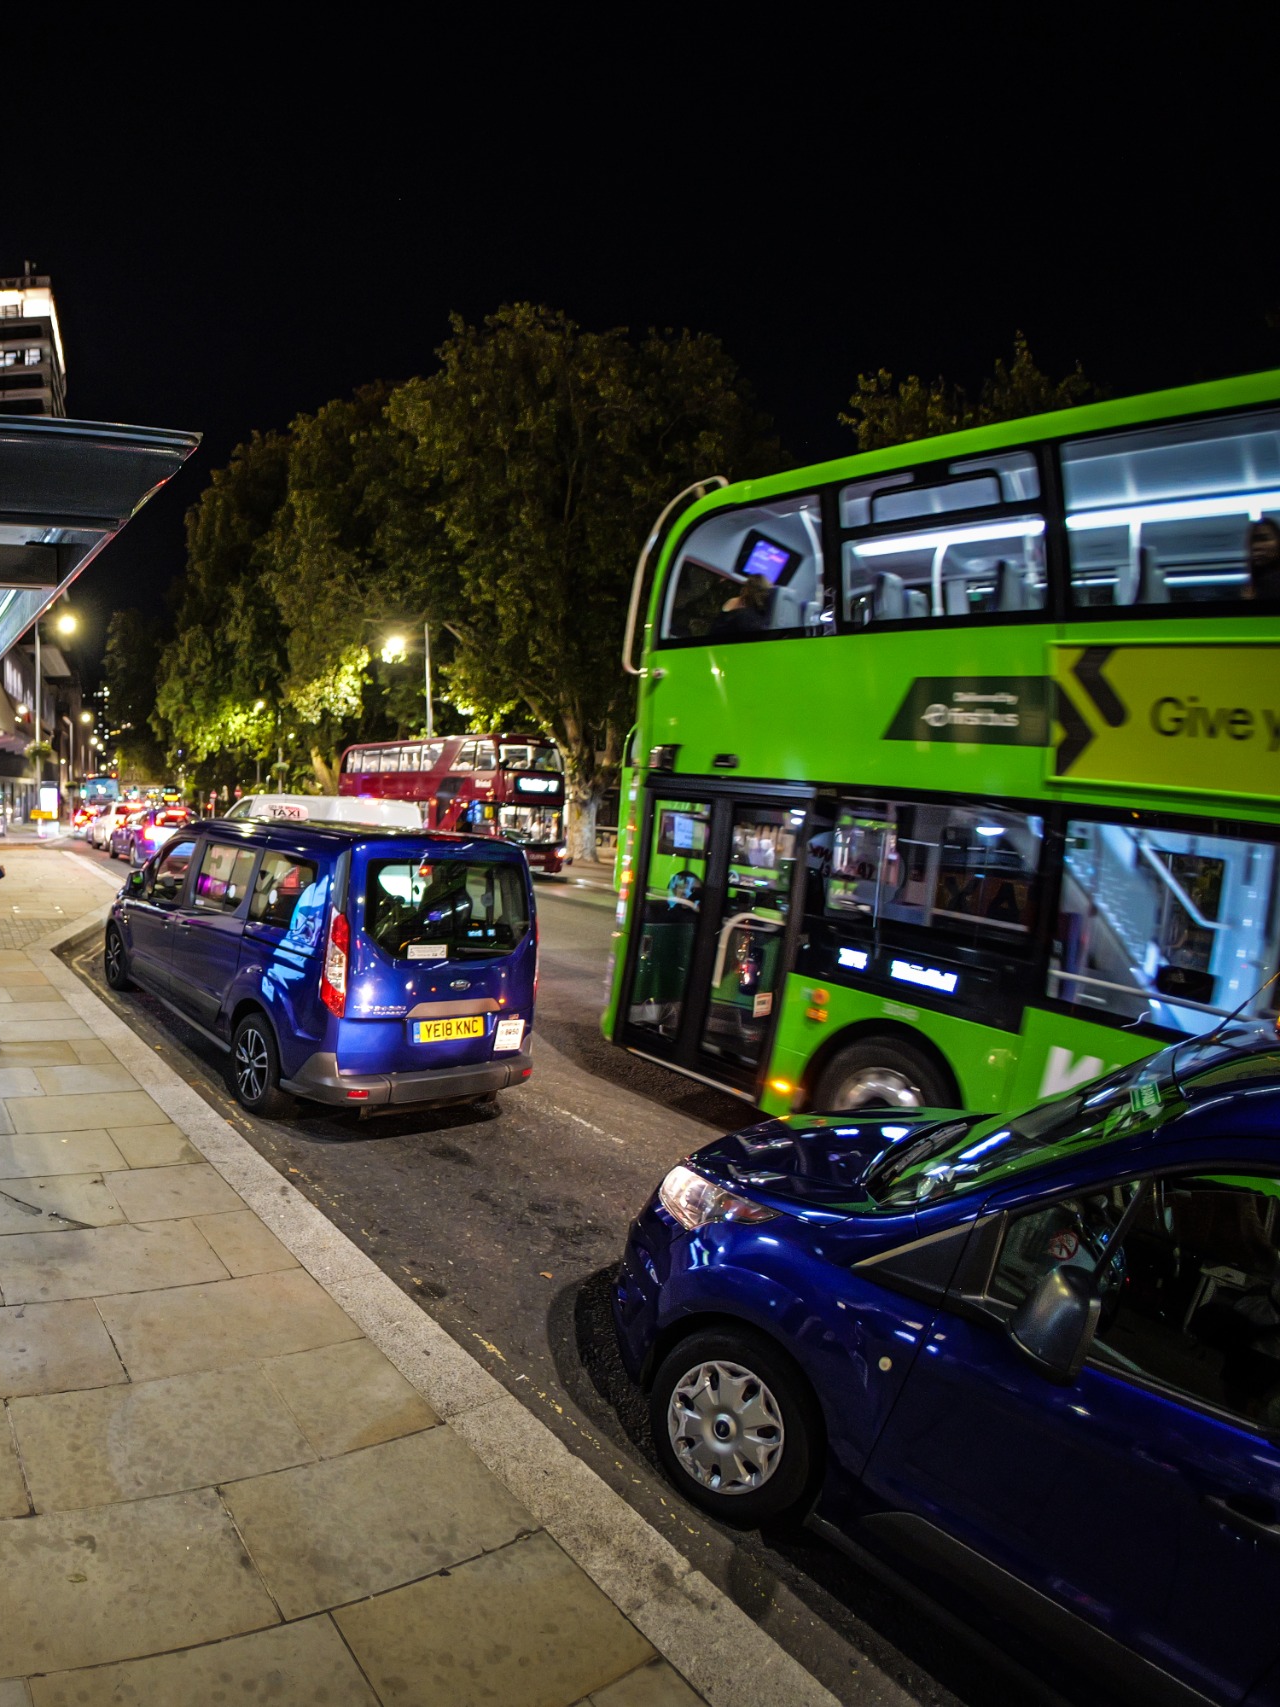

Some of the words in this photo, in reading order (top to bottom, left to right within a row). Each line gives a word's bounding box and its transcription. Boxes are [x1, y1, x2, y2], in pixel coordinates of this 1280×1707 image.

[1149, 695, 1256, 741] Give
[270, 808, 300, 817] TAXI
[425, 1022, 453, 1039] YE18
[456, 1019, 480, 1036] KNC
